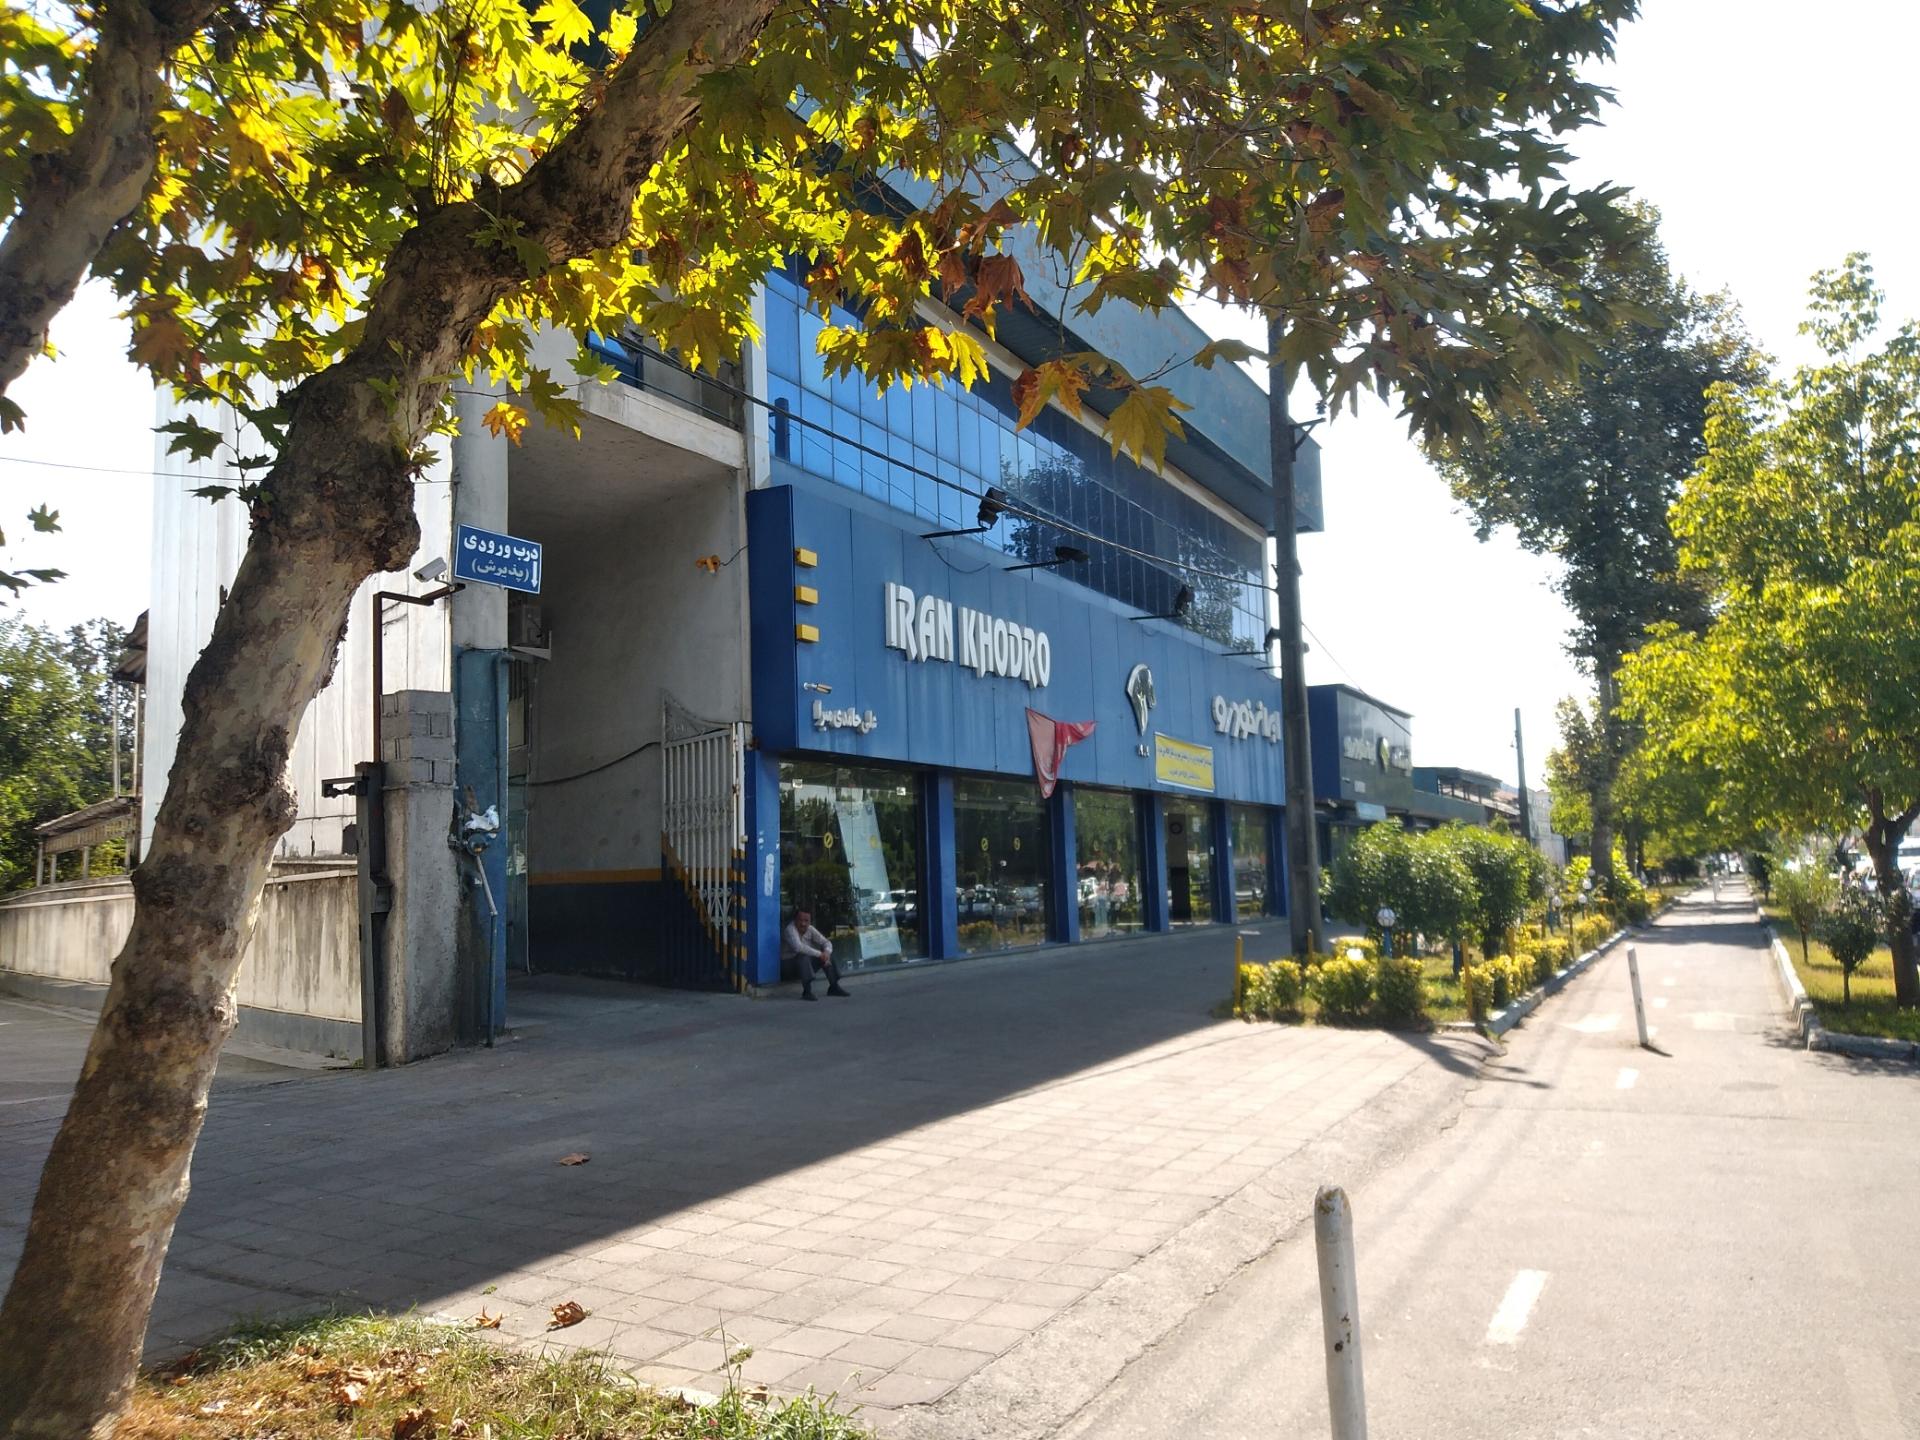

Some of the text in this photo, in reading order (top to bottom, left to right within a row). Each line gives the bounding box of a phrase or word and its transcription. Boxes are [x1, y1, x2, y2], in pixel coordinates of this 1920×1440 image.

[464, 535, 538, 561] درب ورودی
[885, 582, 1050, 689] IRAN KHODRO
